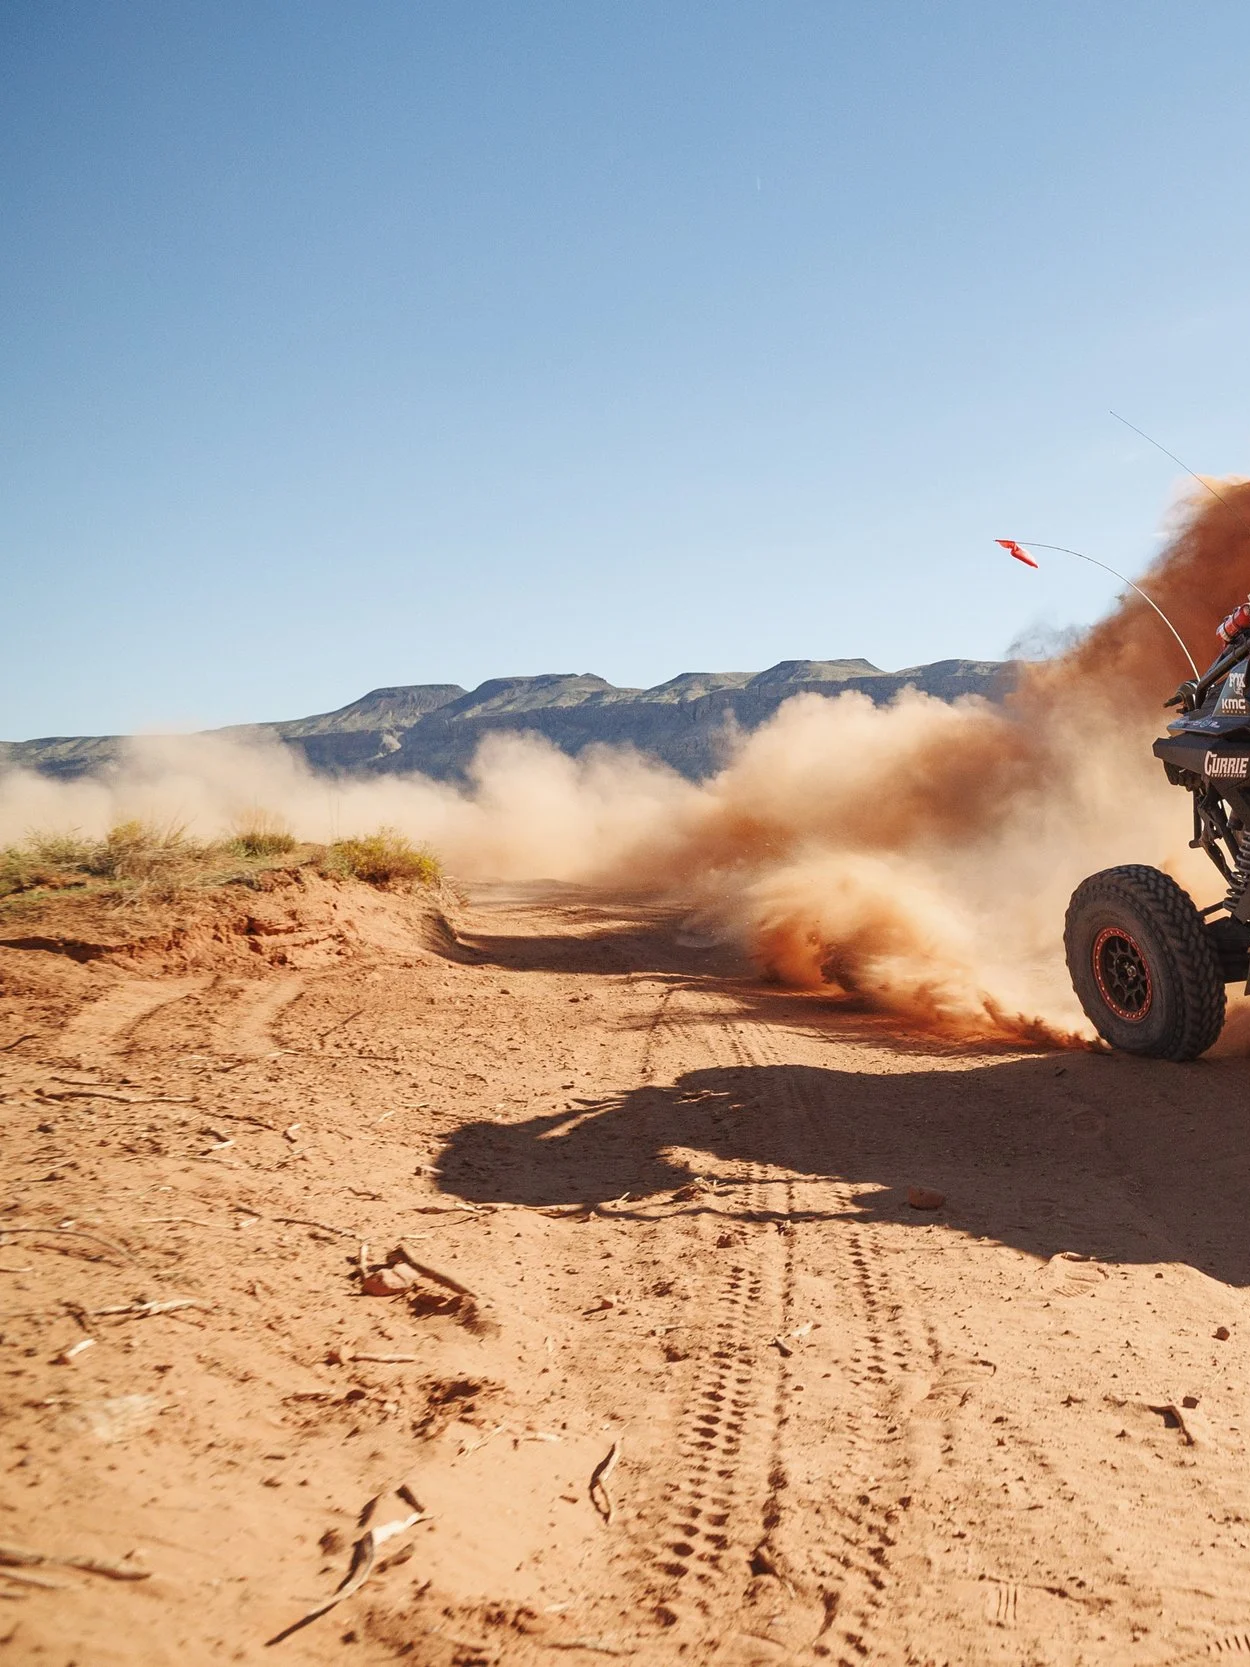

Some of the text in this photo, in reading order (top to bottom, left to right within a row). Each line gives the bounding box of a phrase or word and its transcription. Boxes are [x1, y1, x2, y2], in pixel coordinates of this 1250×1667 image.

[1229, 672, 1246, 691] FOX
[1221, 698, 1246, 710] KMC
[1204, 750, 1249, 776] CURRIE
